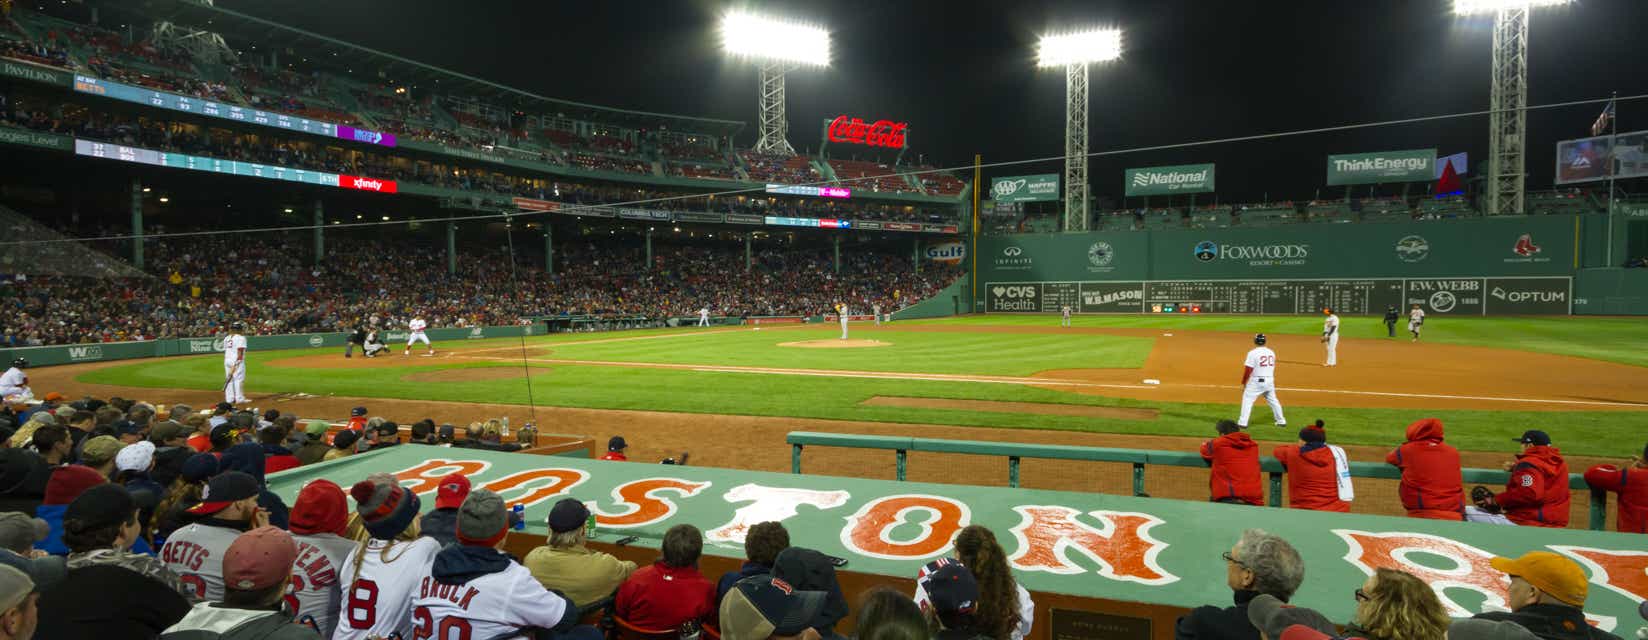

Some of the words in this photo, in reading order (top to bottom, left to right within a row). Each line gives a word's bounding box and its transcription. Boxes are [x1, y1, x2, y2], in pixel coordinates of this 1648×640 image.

[4, 63, 58, 82] PAVILION
[829, 115, 908, 148] Coca-Cola
[1333, 158, 1427, 172] ThinkEnergy
[354, 178, 382, 191] xfinity
[1149, 170, 1207, 185] National
[927, 245, 963, 258] Gulf
[1221, 244, 1310, 260] FOXWOODS
[1006, 286, 1036, 299] CVS
[1437, 280, 1479, 291] WEBB
[1508, 291, 1565, 303] OPTUM
[994, 298, 1036, 311] Health
[1259, 355, 1274, 367] 20
[296, 458, 1181, 586] BOSTON
[162, 540, 210, 572] BETTS
[348, 578, 379, 630] 8
[412, 605, 472, 640] 20
